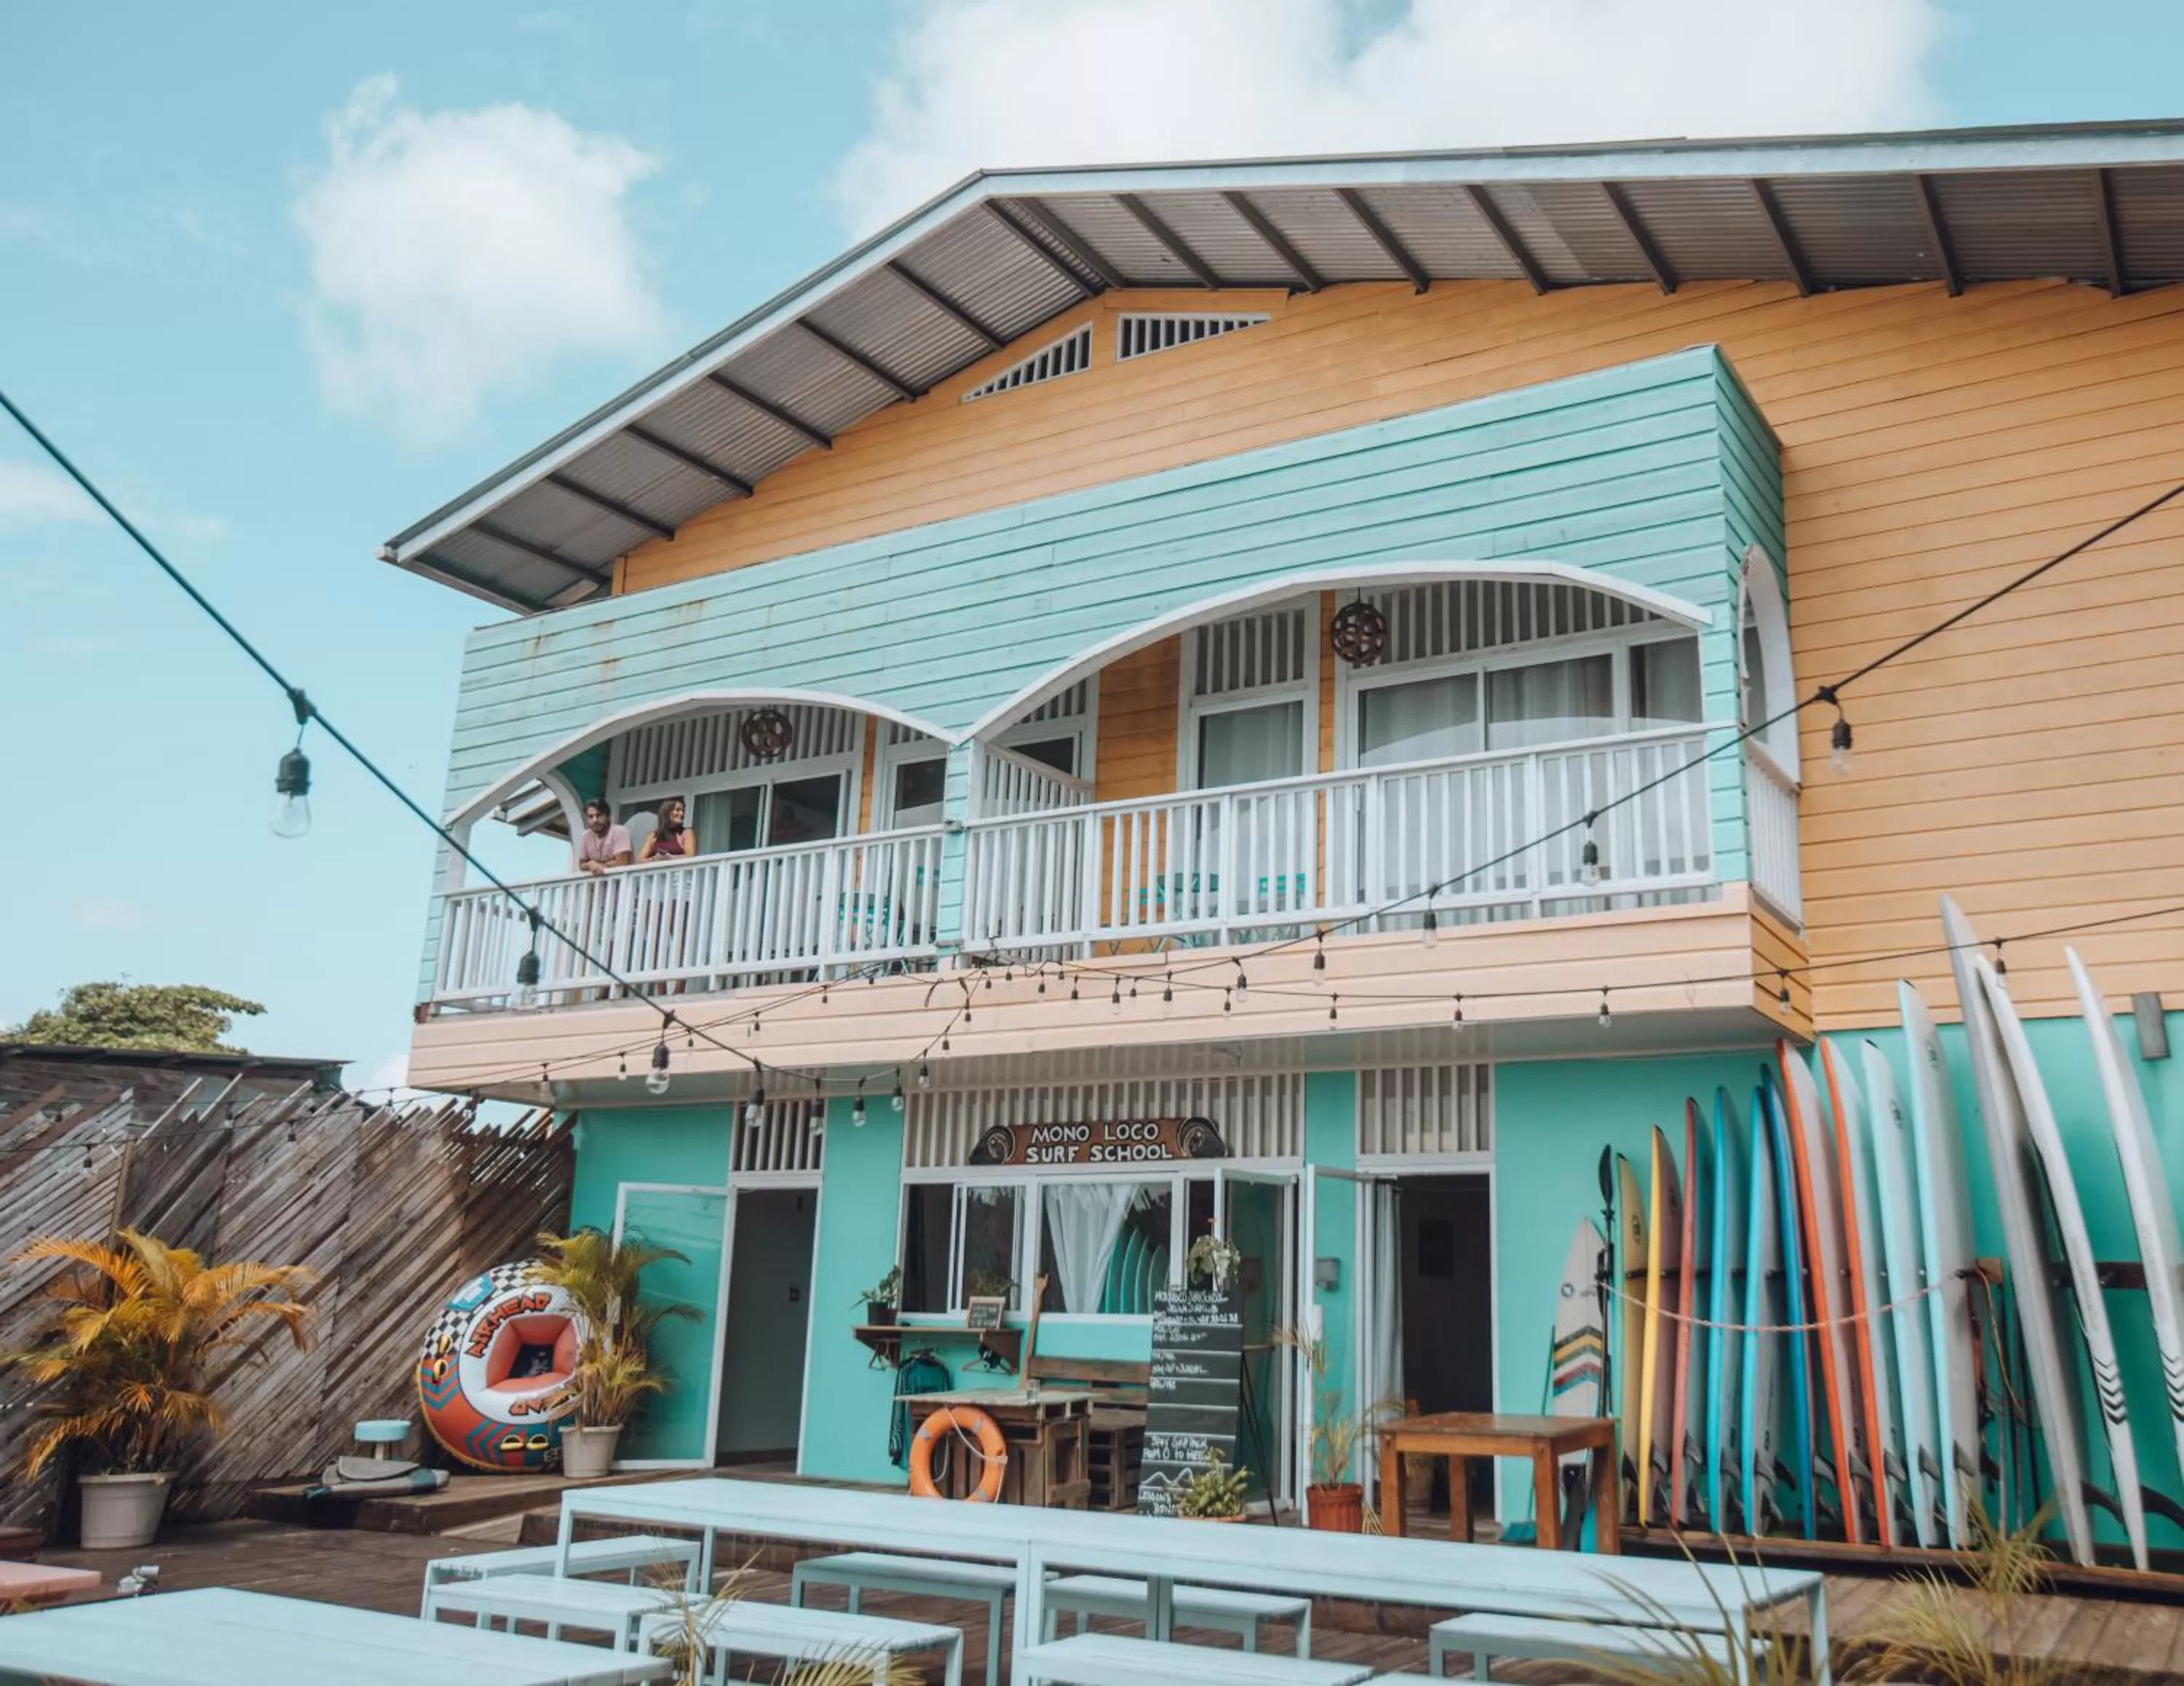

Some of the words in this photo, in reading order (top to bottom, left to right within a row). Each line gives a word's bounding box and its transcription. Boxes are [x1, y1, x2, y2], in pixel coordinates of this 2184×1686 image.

[1032, 1125, 1090, 1143] MONO
[1104, 1123, 1159, 1140] LOCO
[1025, 1145, 1080, 1163] SURF
[1090, 1144, 1173, 1162] SCHOOL
[464, 1291, 553, 1359] AIRHEAD
